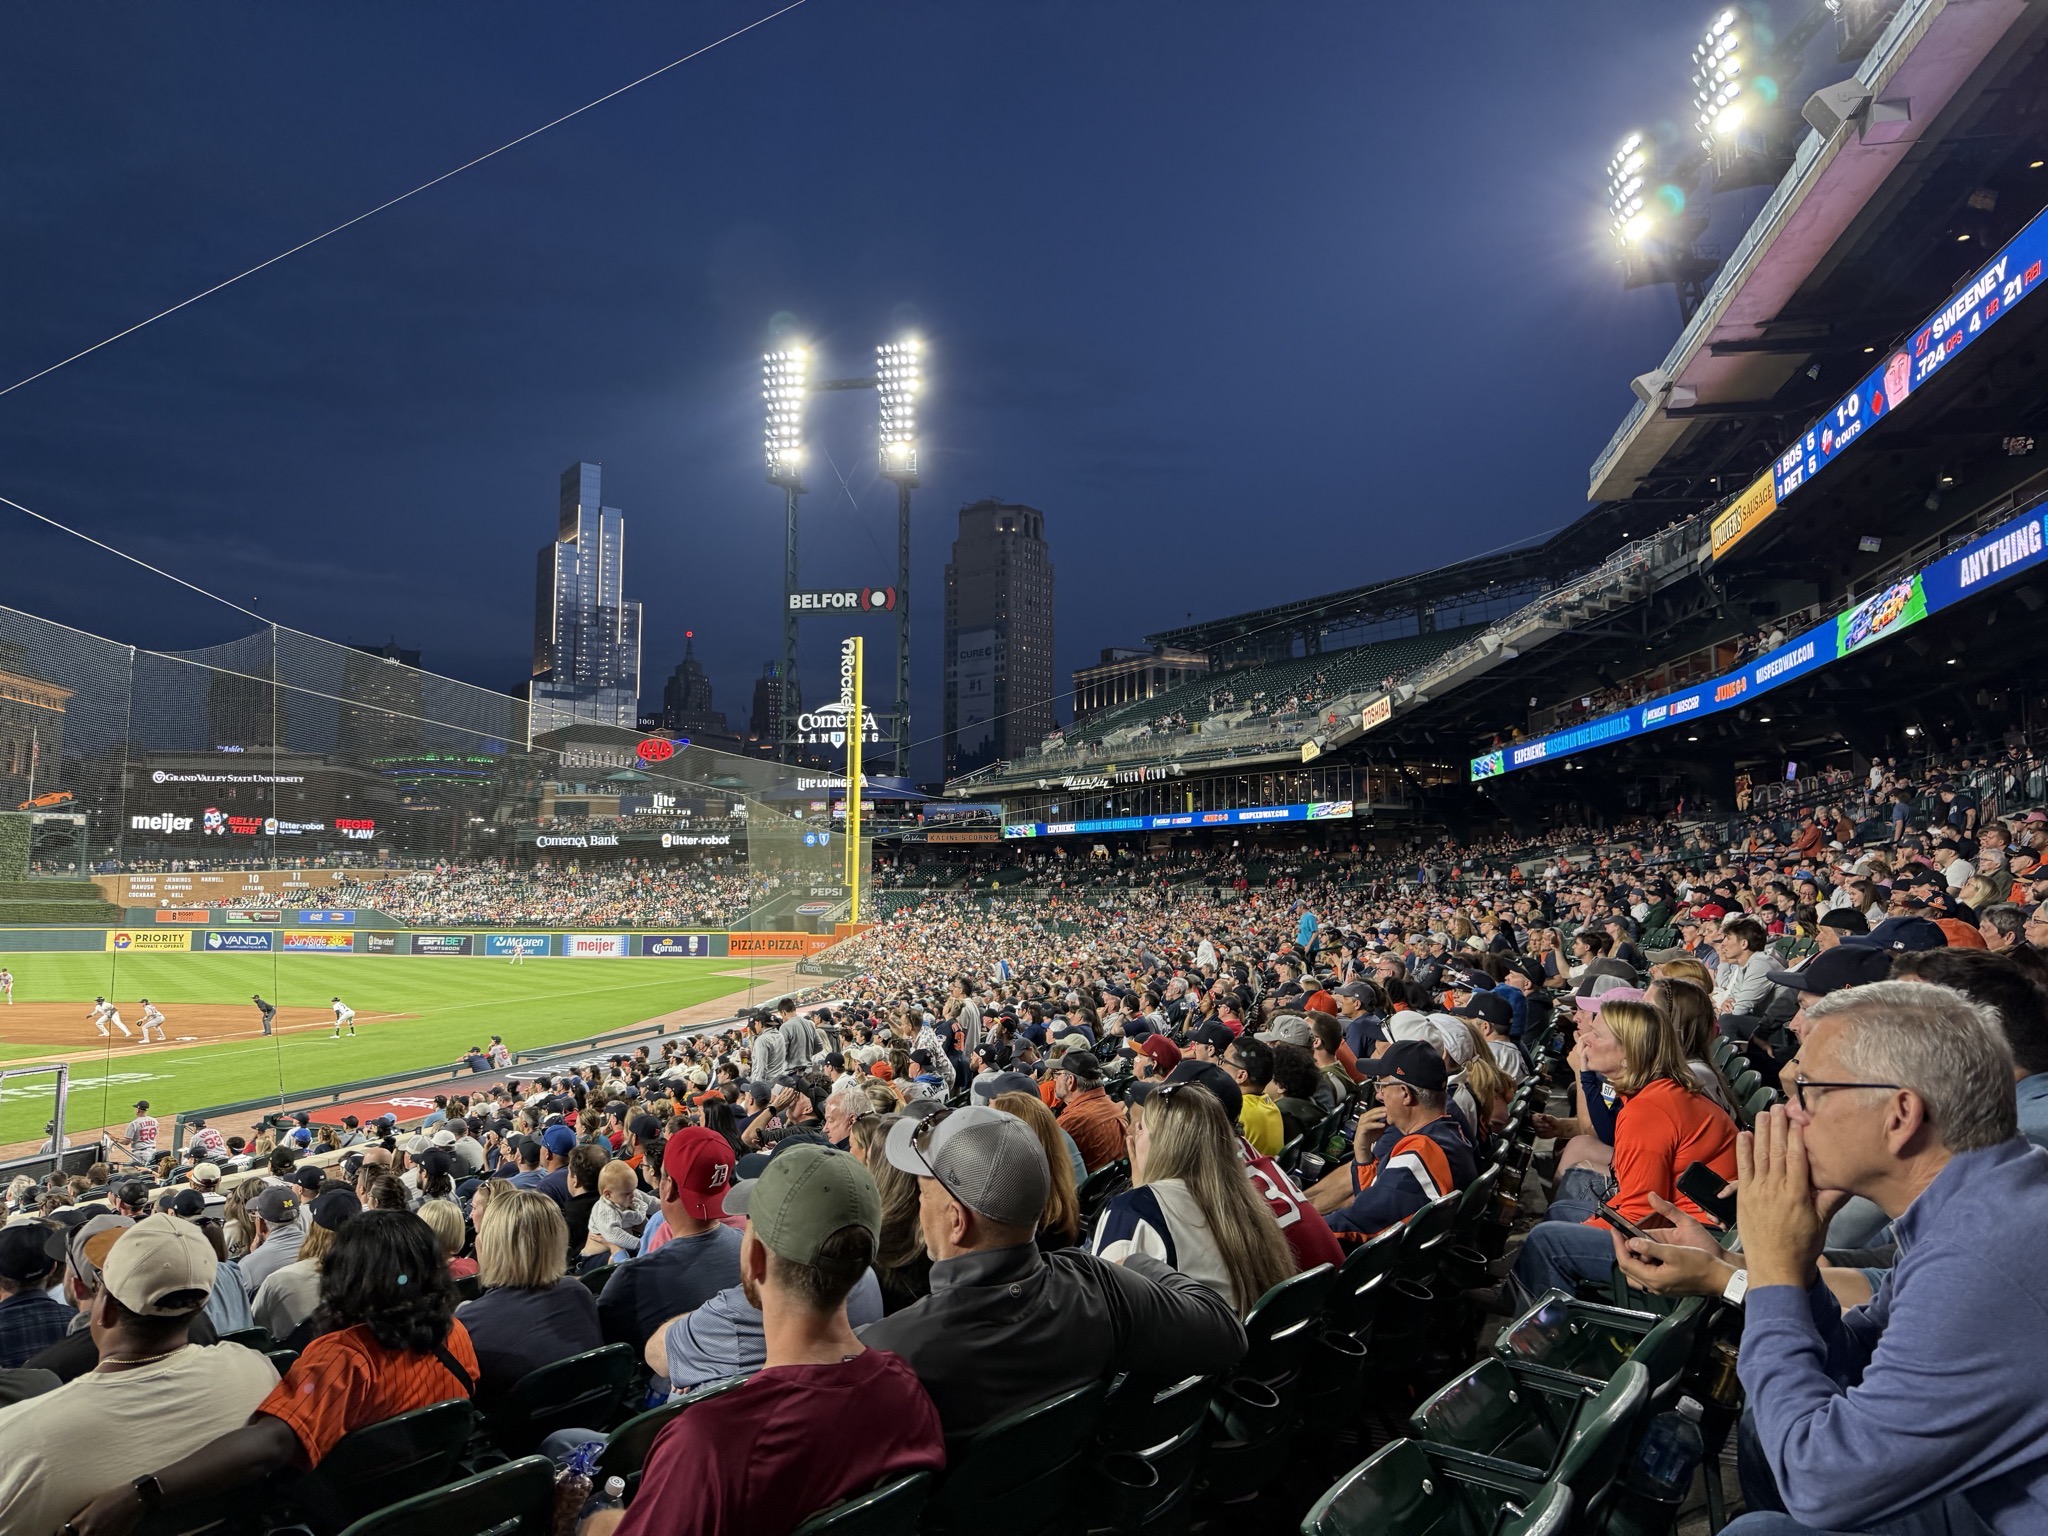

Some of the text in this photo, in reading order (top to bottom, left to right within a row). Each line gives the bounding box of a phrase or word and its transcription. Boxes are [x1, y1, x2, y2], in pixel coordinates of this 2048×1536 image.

[1916, 256, 2007, 358] 27 SWEENEY
[1916, 260, 2041, 381] .724 OPS 4 HR 21 RBI
[1837, 393, 1859, 427] 1-0
[1842, 420, 1861, 444] OUTS
[1782, 443, 1802, 473] BOS
[1806, 431, 1815, 451] 5
[1783, 464, 1803, 495] DET
[1808, 454, 1817, 474] 5
[1742, 483, 1773, 521] SAUSAGE
[1960, 520, 2042, 588] ANYTHING
[789, 592, 858, 609] BELFOR
[960, 648, 985, 659] CURE
[1756, 641, 1814, 685] MISPEEDWAY.COM
[1715, 681, 1736, 703] JUNE
[1676, 695, 1700, 714] NASCAR
[1363, 700, 1390, 726] TOSHIBA
[638, 718, 656, 726] 1001
[1514, 742, 1545, 765] EXPERIENCE
[1546, 736, 1569, 756] NASCAR
[1569, 735, 1577, 747] IN
[1577, 730, 1590, 745] THE
[1591, 722, 1609, 741] IRISH
[1609, 715, 1631, 736] HILLS
[640, 740, 670, 760] AAA
[166, 774, 304, 783] GRAND VALLEY STATE UNIVERSITY
[1115, 768, 1166, 784] TIGER CLUB
[797, 778, 816, 791] Lite
[652, 793, 676, 808] Lite
[635, 807, 674, 815] PITCHER'S
[132, 813, 193, 834] meijer
[228, 816, 262, 826] BELLE
[280, 821, 325, 831] litter-robot
[335, 818, 375, 830] FIEGER
[231, 826, 257, 834] TIRE
[349, 829, 374, 839] LAW
[1047, 823, 1075, 834] EXPERIENCE
[590, 835, 619, 846] Bank
[248, 874, 259, 884] 10
[292, 872, 301, 881] 11
[331, 871, 344, 880] 42
[810, 887, 843, 896] PEPSI
[135, 934, 184, 942] PRIORITY
[222, 935, 268, 945] VANDA
[289, 934, 327, 948] Surfside
[418, 936, 466, 945] ESPN BET
[506, 937, 544, 947] McLaren
[577, 938, 615, 954] meijer
[652, 943, 682, 954] Corona
[731, 939, 804, 951] PIZZA! PIZZA!
[203, 1135, 223, 1150] 33
[283, 1199, 294, 1208] M
